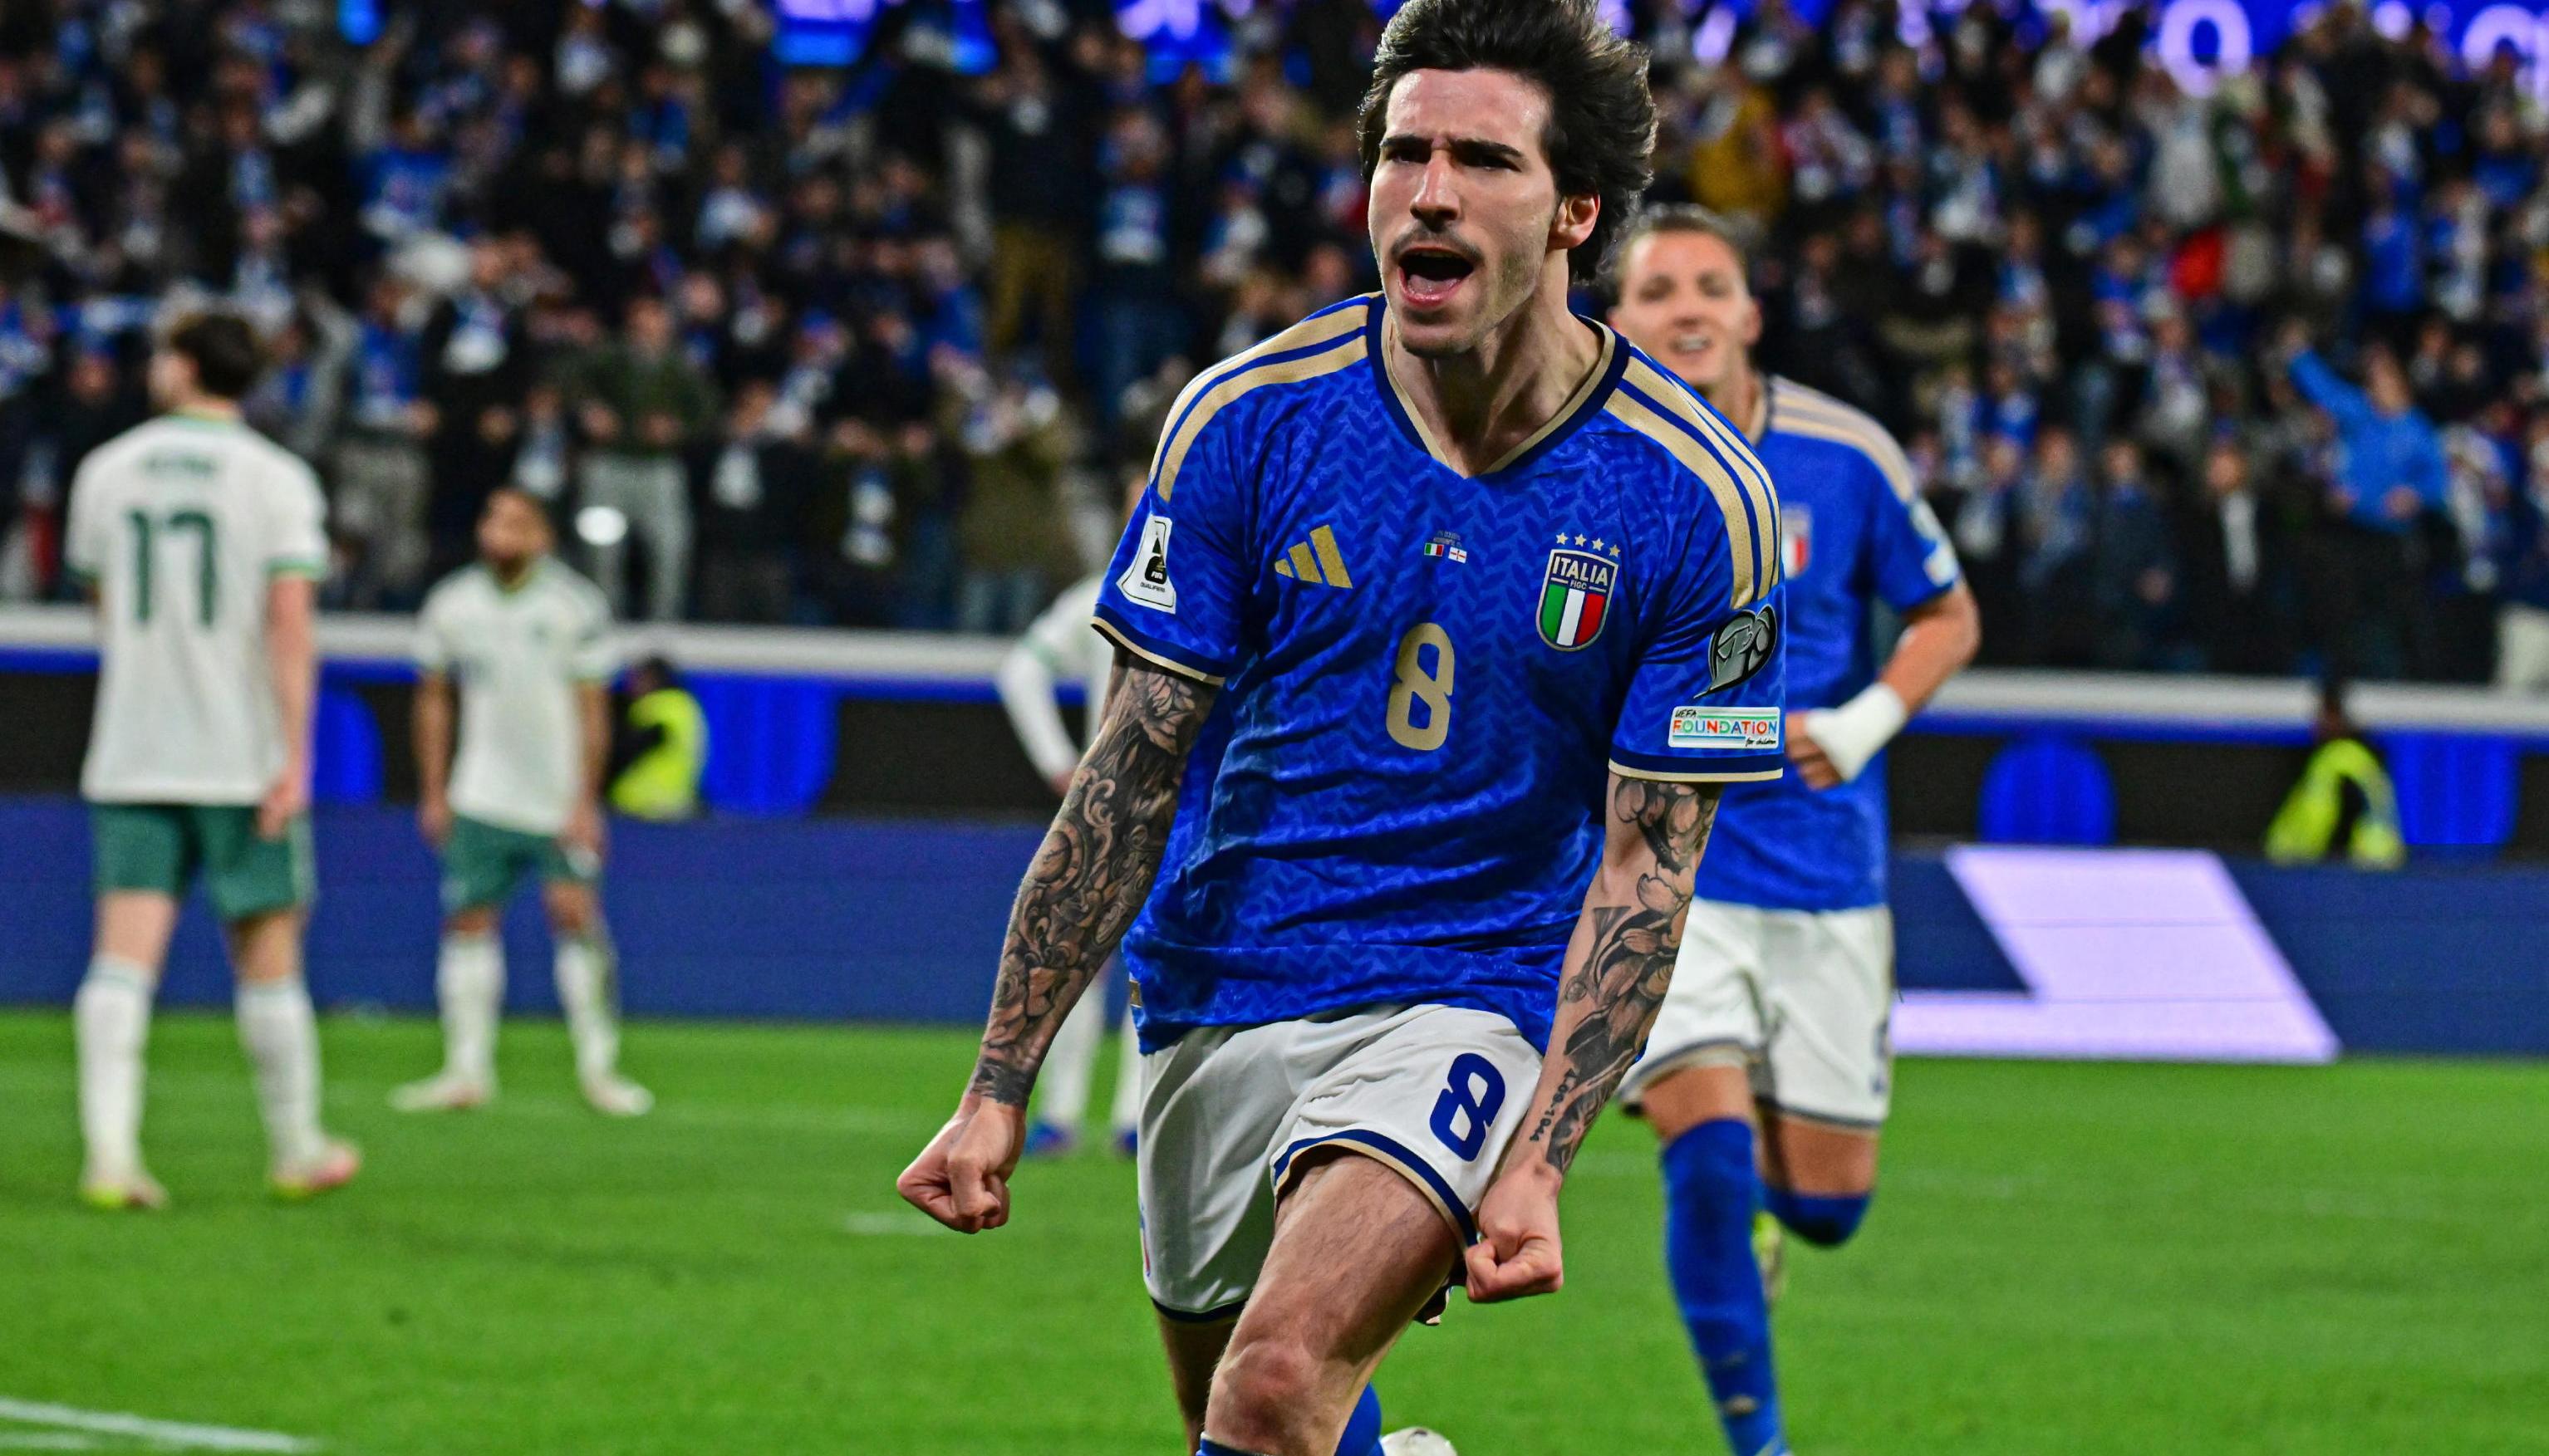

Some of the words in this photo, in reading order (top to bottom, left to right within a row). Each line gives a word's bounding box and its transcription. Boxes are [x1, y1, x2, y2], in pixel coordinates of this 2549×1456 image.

[127, 507, 216, 628] 17
[1551, 556, 1608, 586] ITALIA
[1569, 580, 1588, 591] FIGC
[1386, 622, 1455, 751] 8
[1672, 719, 1778, 735] FOUNDATION
[1675, 708, 1697, 718] UEFA
[1429, 1052, 1505, 1162] 8
